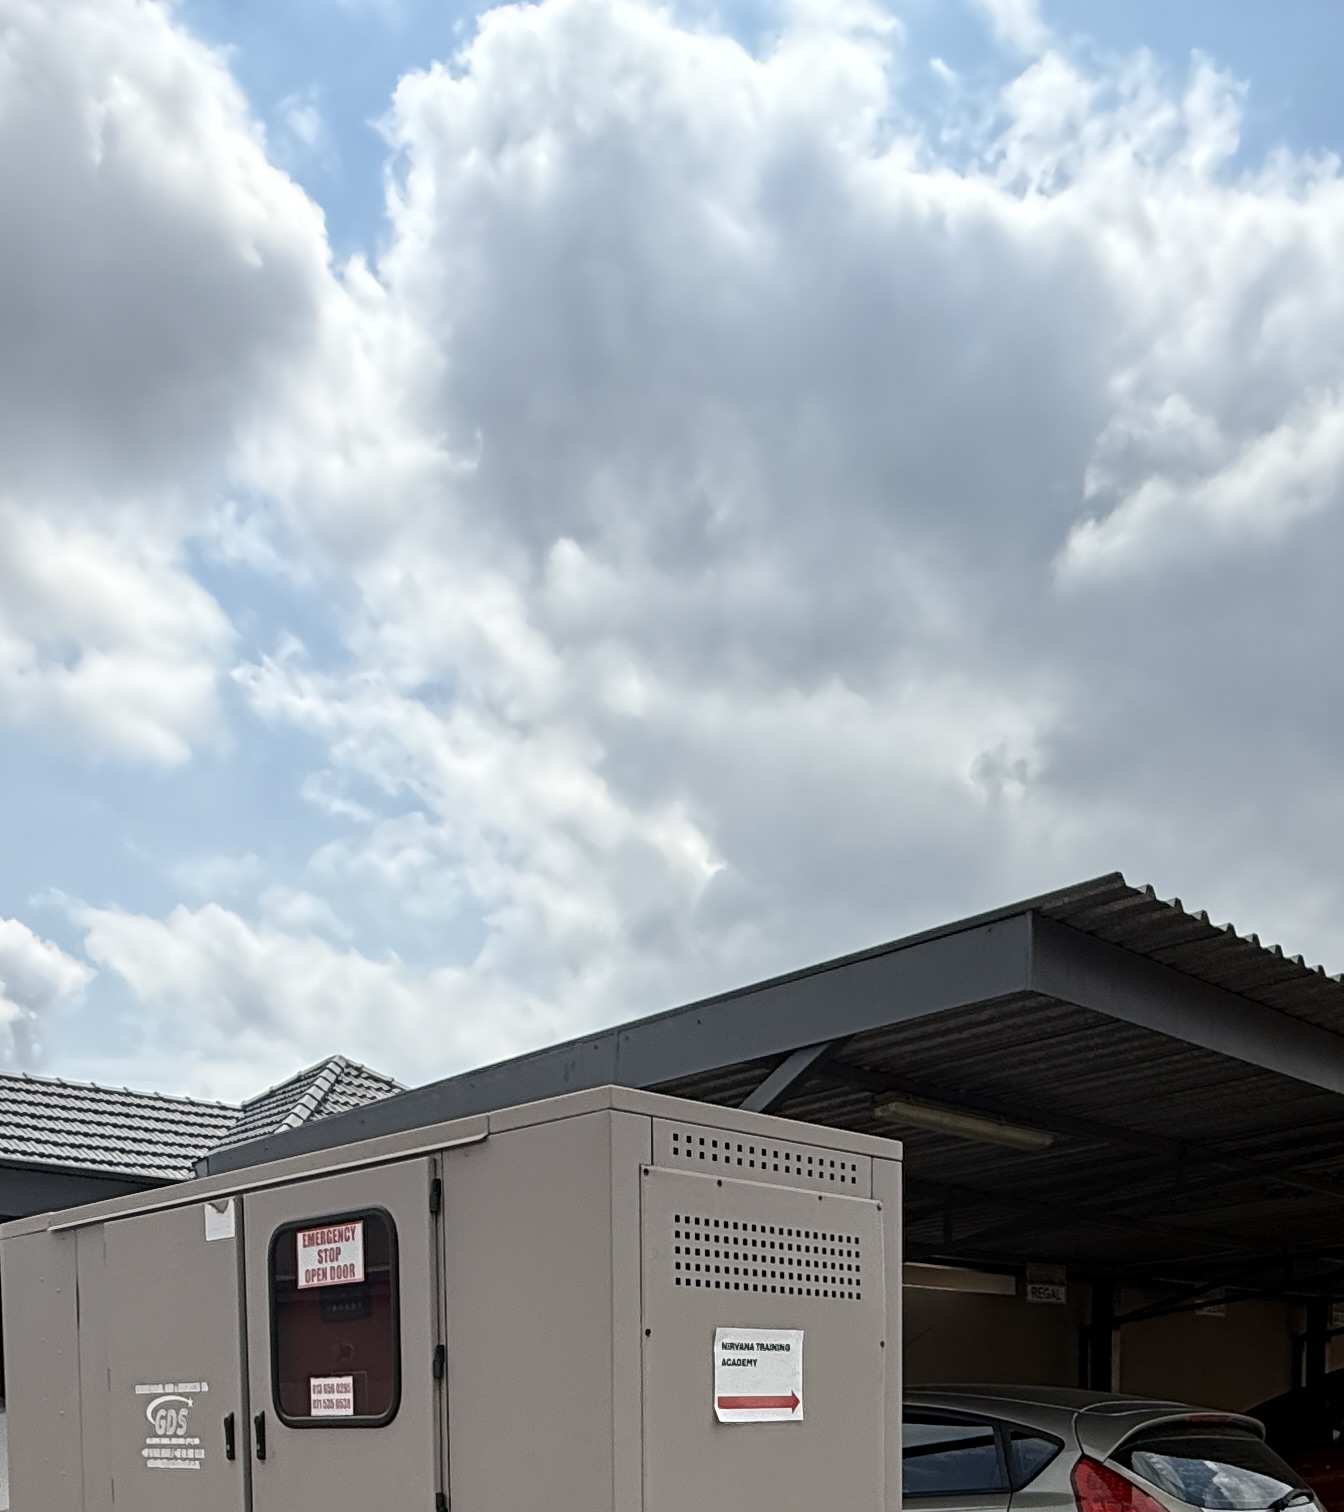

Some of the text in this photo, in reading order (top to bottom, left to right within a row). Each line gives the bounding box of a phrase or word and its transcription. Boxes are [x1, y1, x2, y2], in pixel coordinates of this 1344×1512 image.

[302, 1226, 356, 1248] EMERGENCY
[317, 1246, 342, 1264] STOP
[305, 1263, 356, 1283] OPEN DOOR
[1031, 1286, 1062, 1300] REGAL
[722, 1342, 790, 1352] NIRVANA TRAINING
[722, 1358, 757, 1367] ACADEMY
[156, 1408, 188, 1435] GDS
